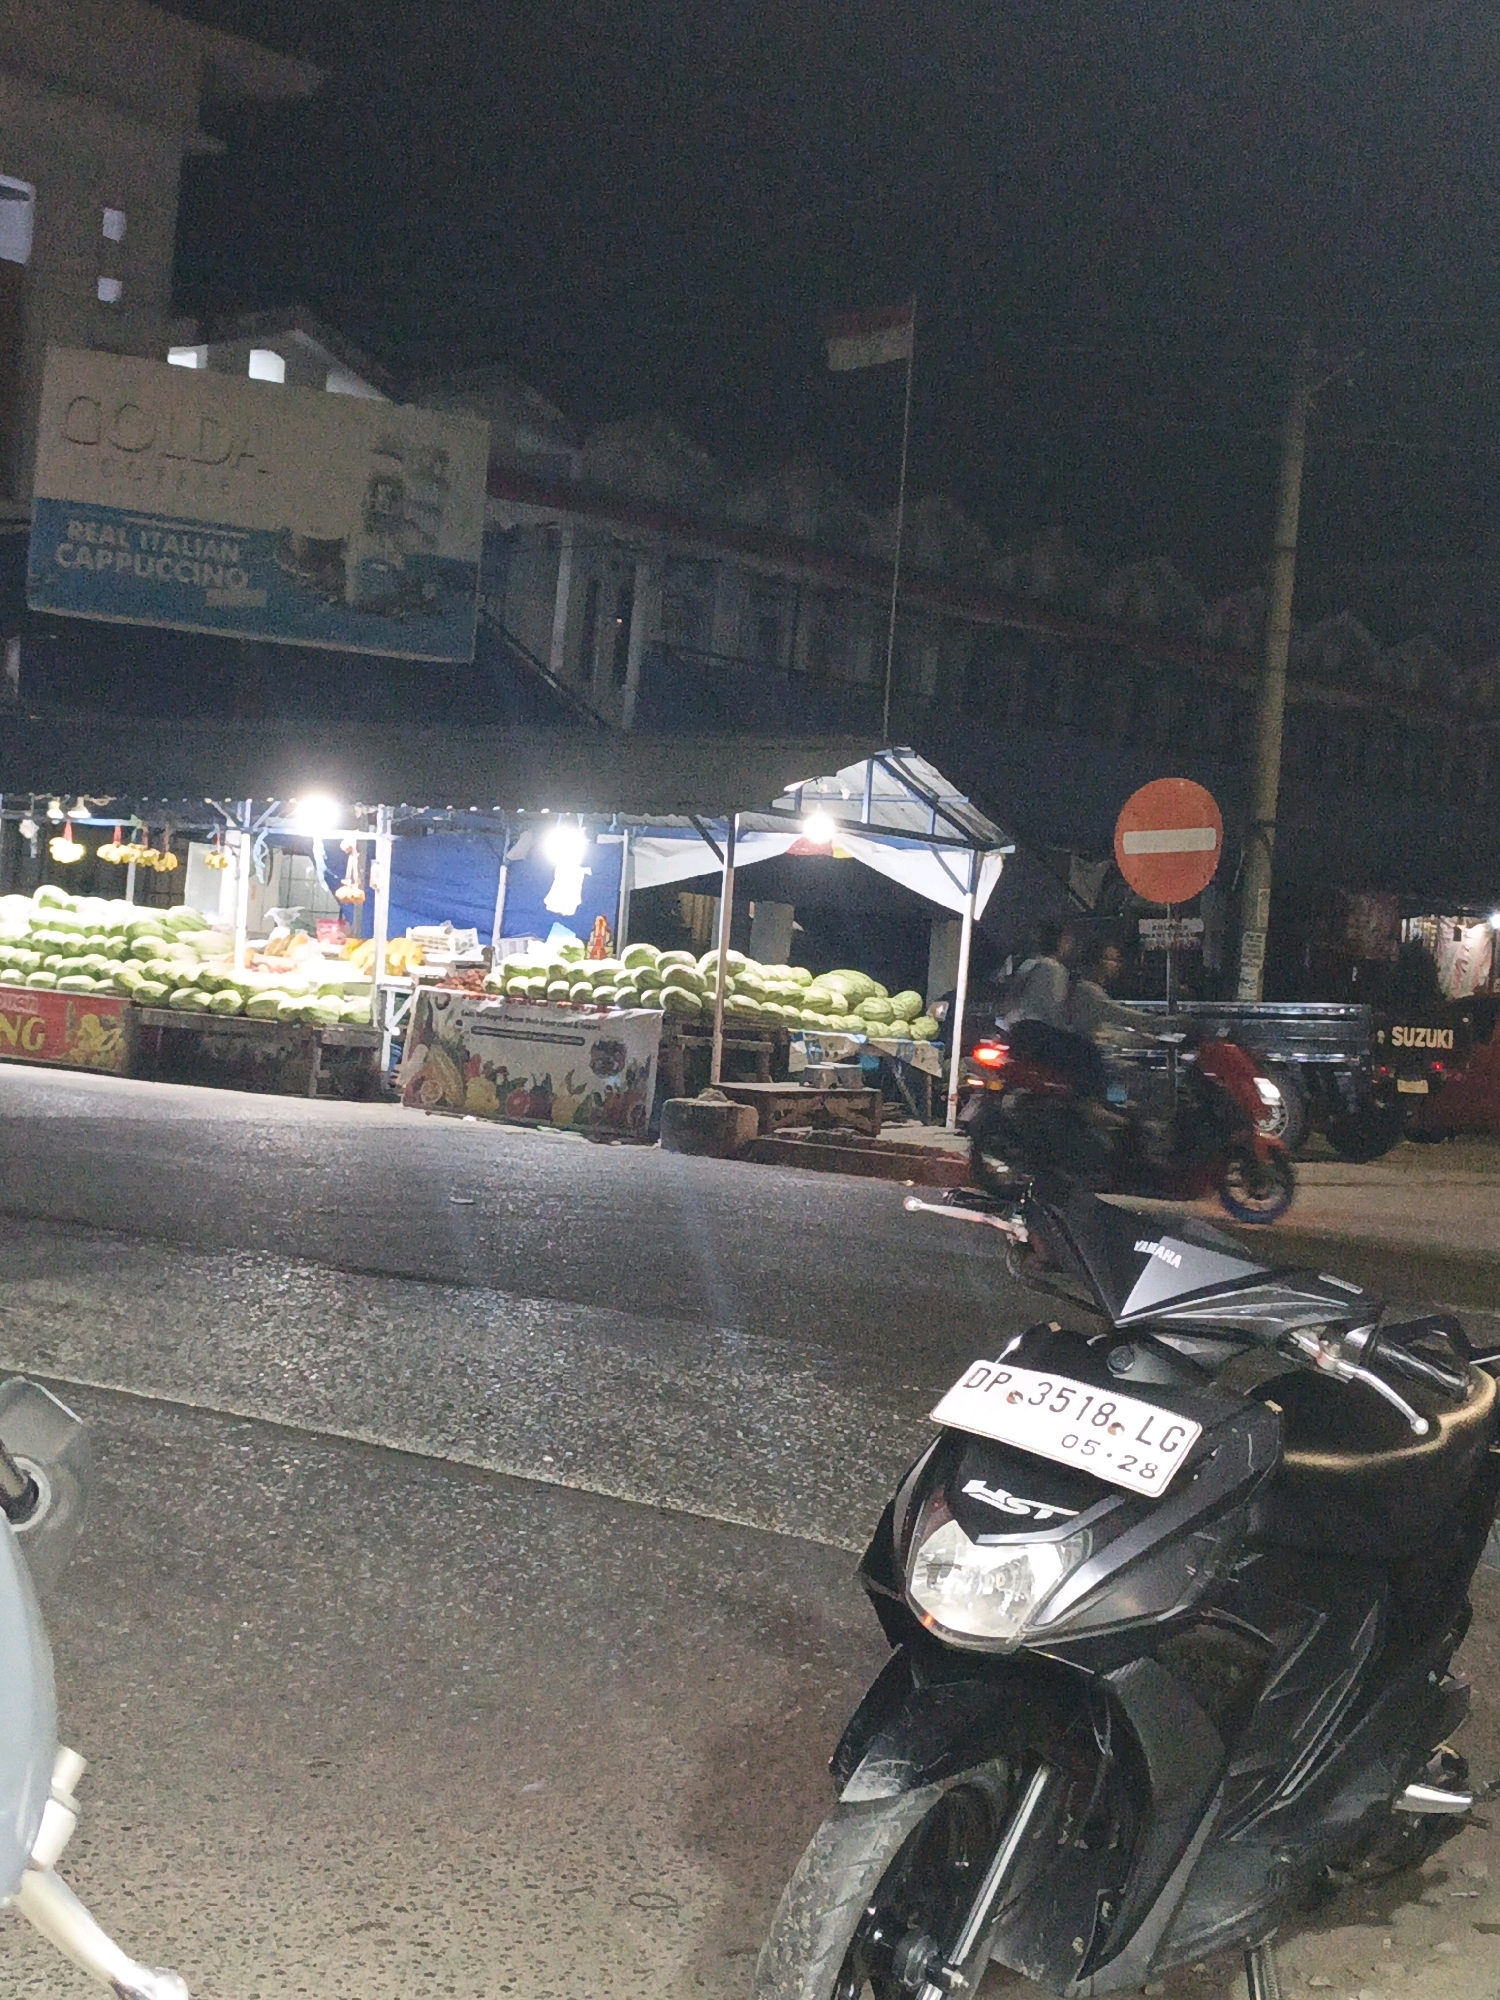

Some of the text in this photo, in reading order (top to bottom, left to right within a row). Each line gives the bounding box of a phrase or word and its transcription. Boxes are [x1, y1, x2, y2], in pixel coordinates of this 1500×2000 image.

[67, 519, 239, 563] REAL ITALIAN
[55, 543, 249, 590] CAPPUCCINO
[1391, 1025, 1454, 1050] SUZUKI
[1133, 1240, 1182, 1269] YAMAHA
[963, 1367, 1186, 1453] DP 3518 LG
